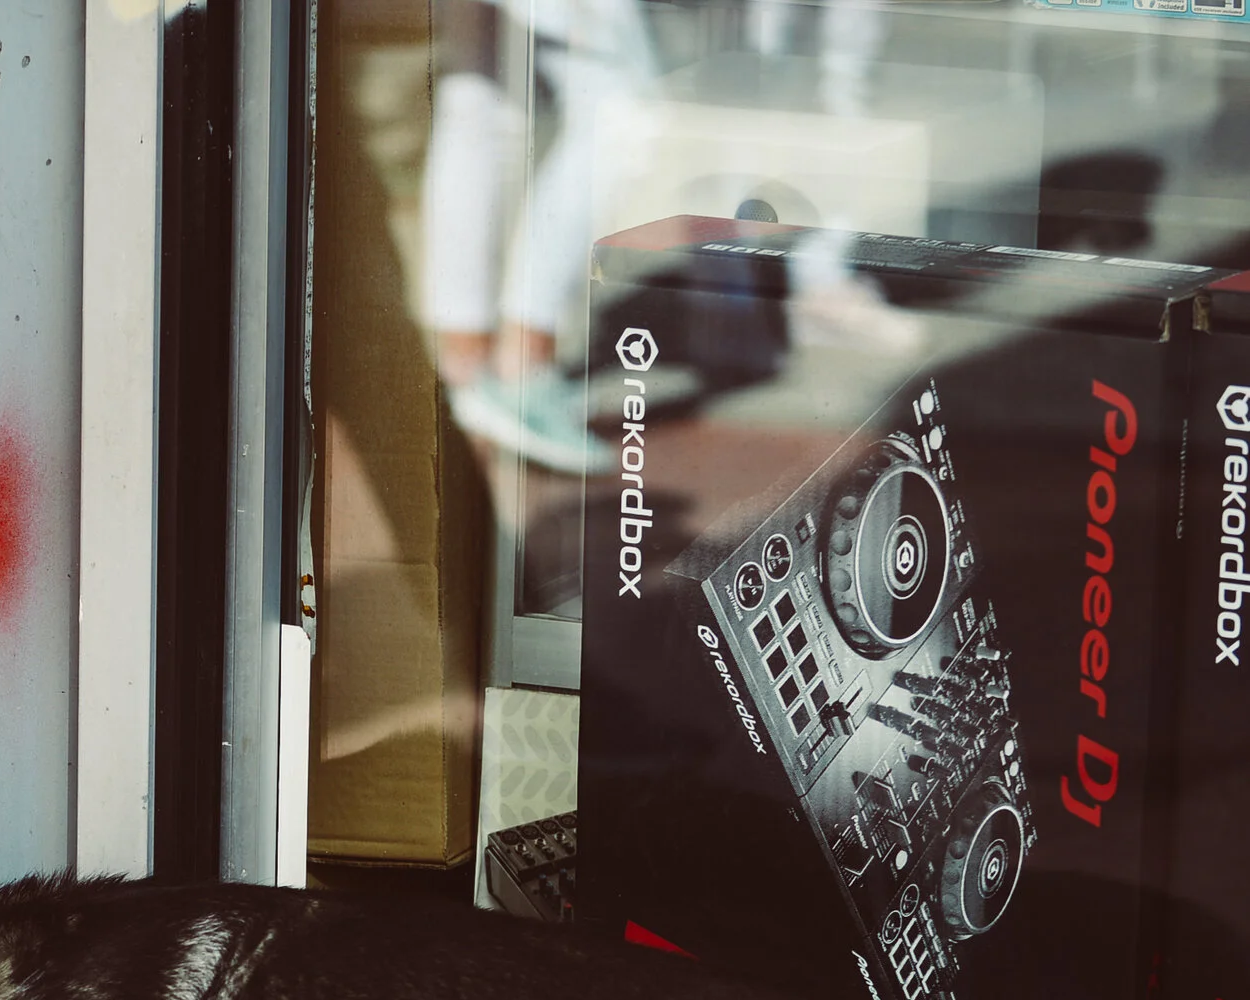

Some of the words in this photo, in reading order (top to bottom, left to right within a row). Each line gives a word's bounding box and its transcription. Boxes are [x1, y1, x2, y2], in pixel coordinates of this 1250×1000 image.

[618, 378, 653, 599] rekordbox
[1079, 379, 1138, 719] Pioneer
[1215, 437, 1250, 666] rekordbox
[709, 651, 767, 755] rekordbox
